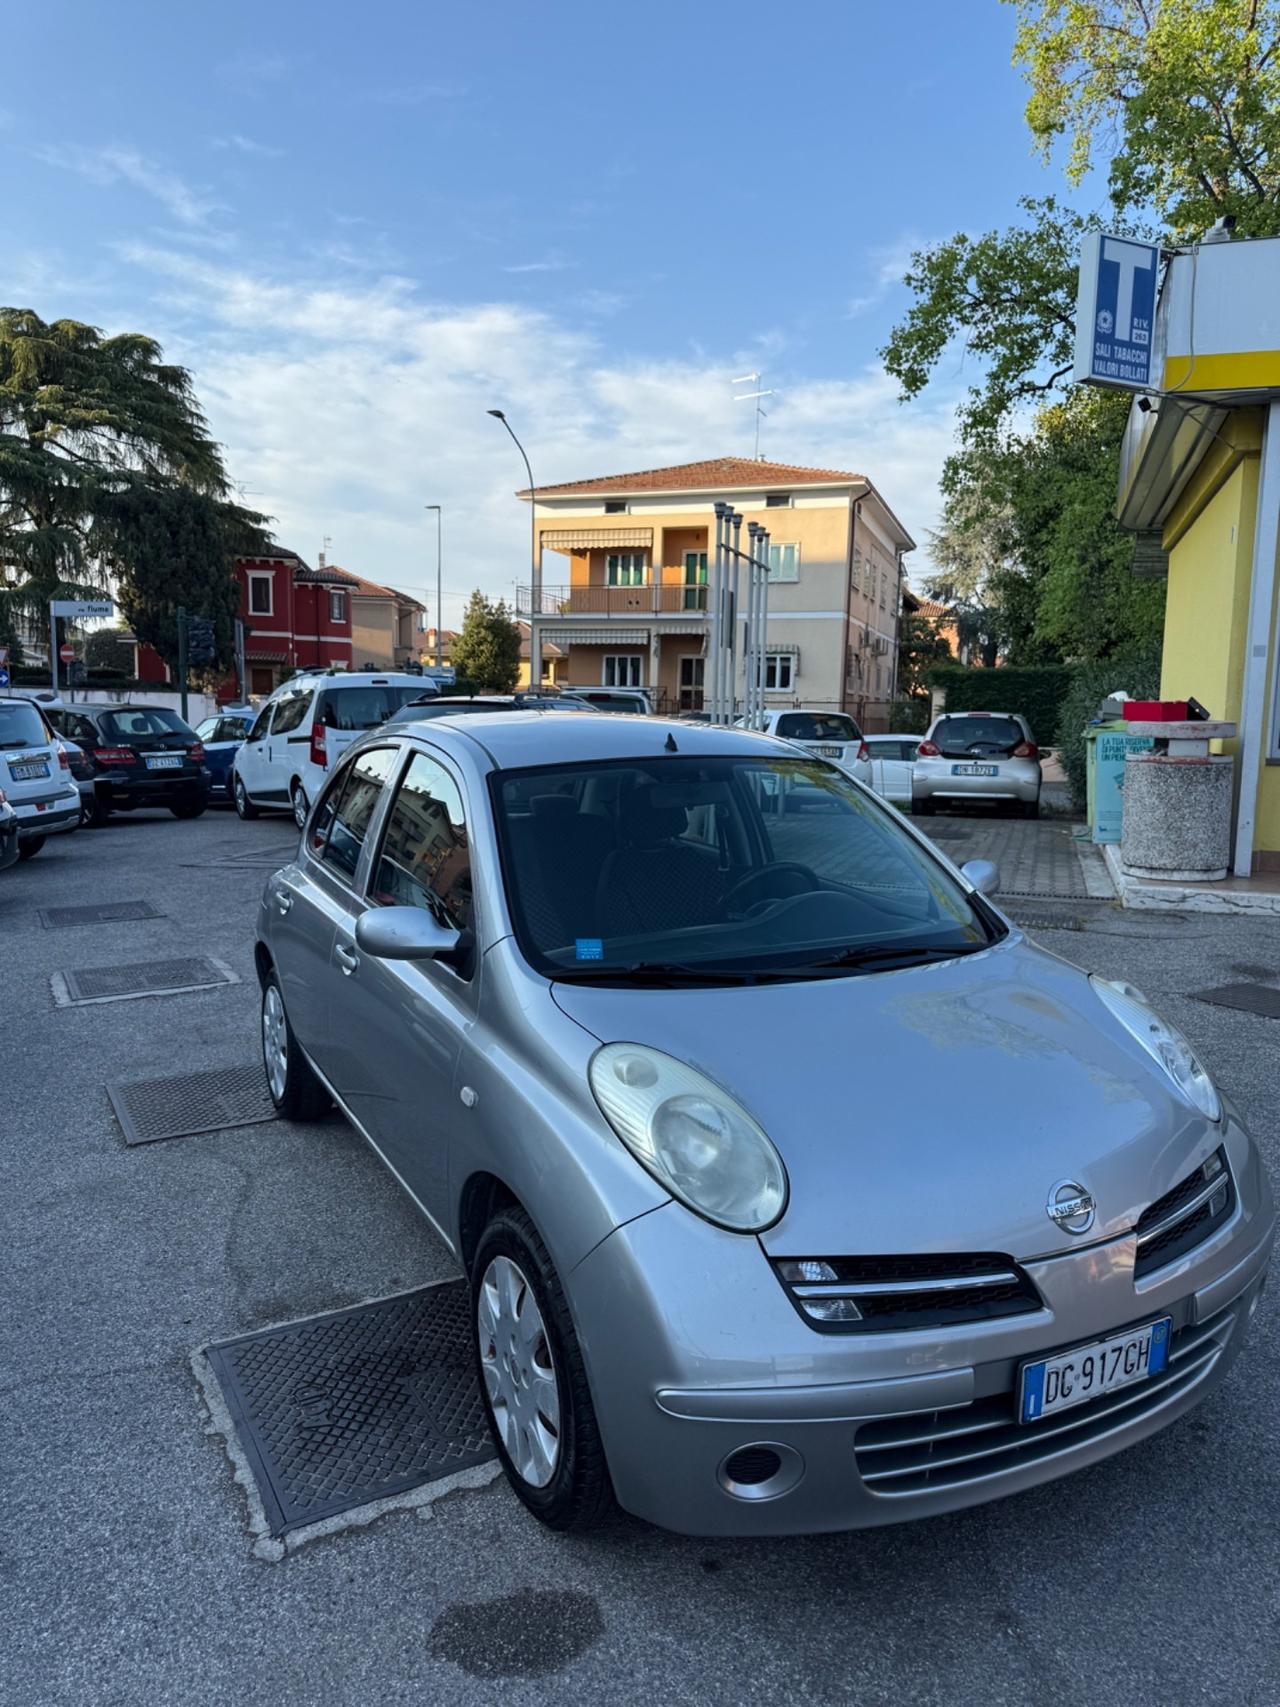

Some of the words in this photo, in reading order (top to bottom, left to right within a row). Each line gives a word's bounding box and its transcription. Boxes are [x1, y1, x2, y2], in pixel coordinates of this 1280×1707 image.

[1103, 238, 1153, 341] T
[1095, 342, 1111, 358] SALI
[1114, 345, 1148, 364] TABACCHI
[1094, 359, 1119, 376] VALORI
[1120, 364, 1147, 381] BOLLATI
[1102, 737, 1111, 746] LA
[1112, 737, 1124, 746] TUA
[1082, 1335, 1151, 1391] 917GH
